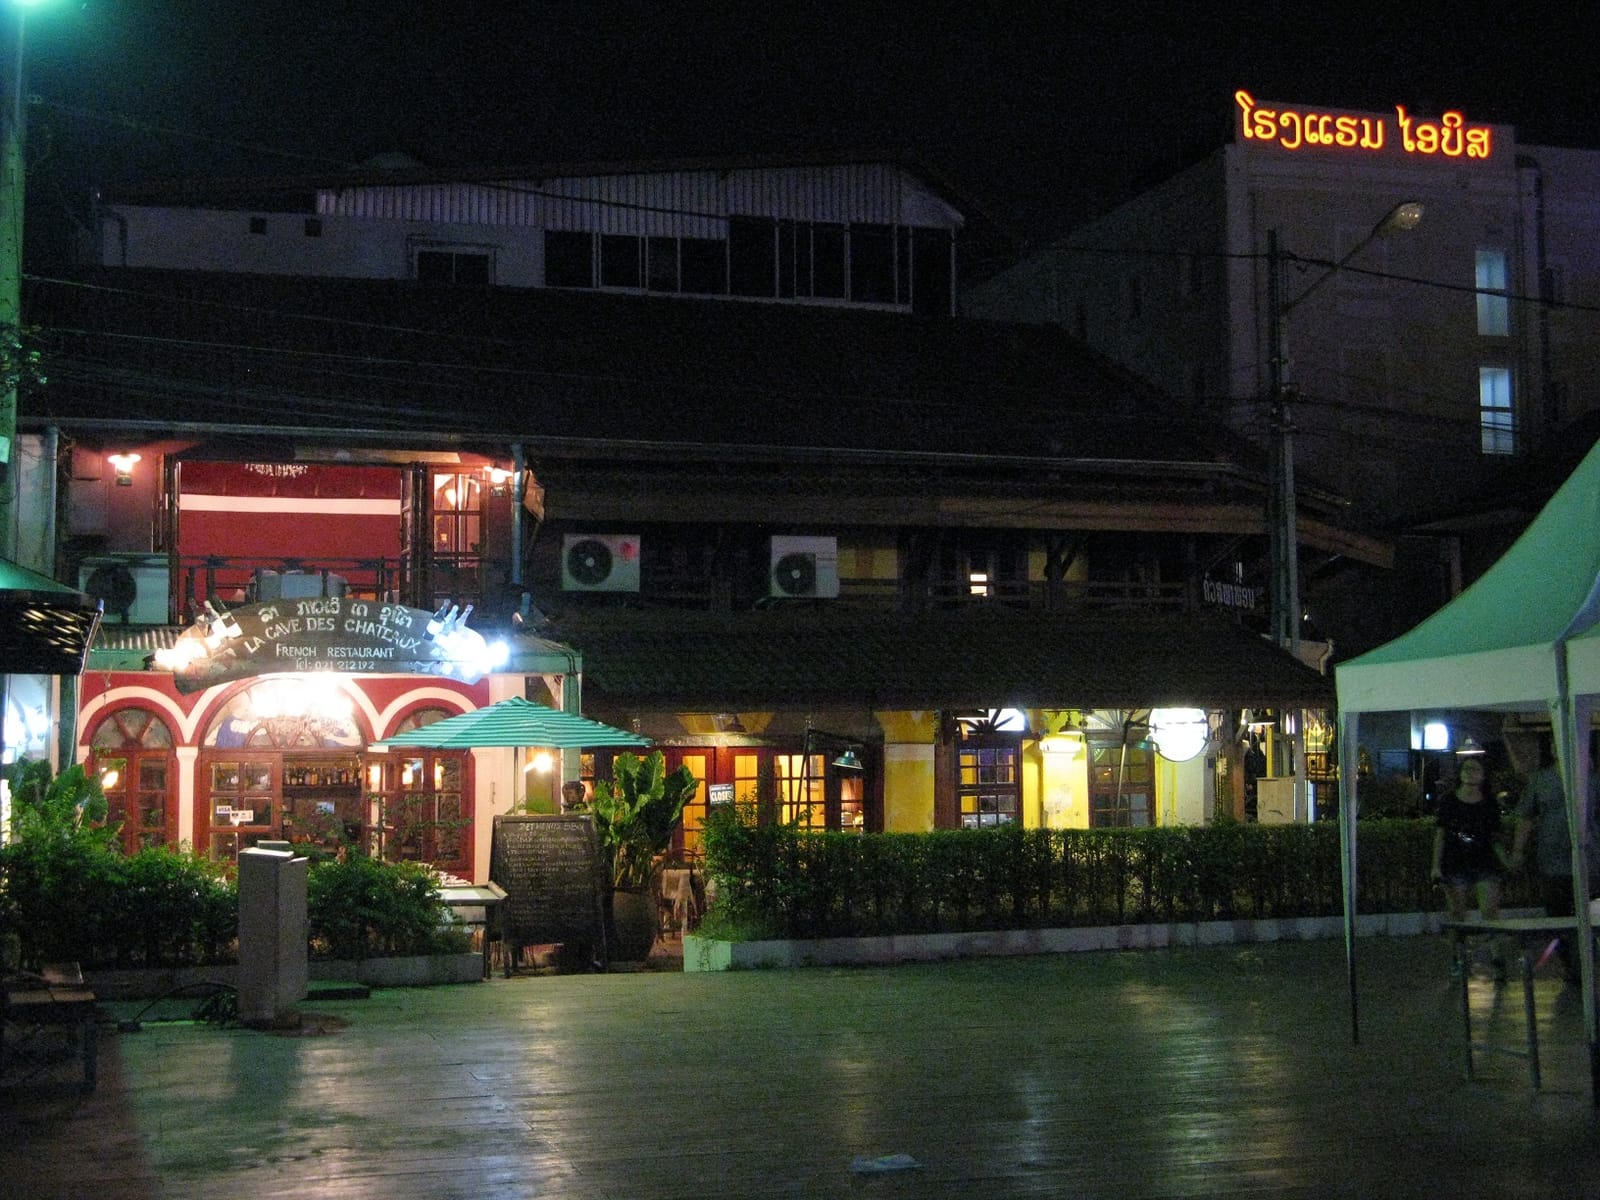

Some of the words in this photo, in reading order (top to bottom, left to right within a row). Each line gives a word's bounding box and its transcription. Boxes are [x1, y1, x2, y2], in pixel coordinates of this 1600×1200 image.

[243, 635, 266, 654] LA
[264, 619, 302, 640] CAVE
[306, 617, 336, 632] DES
[344, 618, 421, 655] CHATEAUX
[327, 646, 395, 658] RESTAURANT
